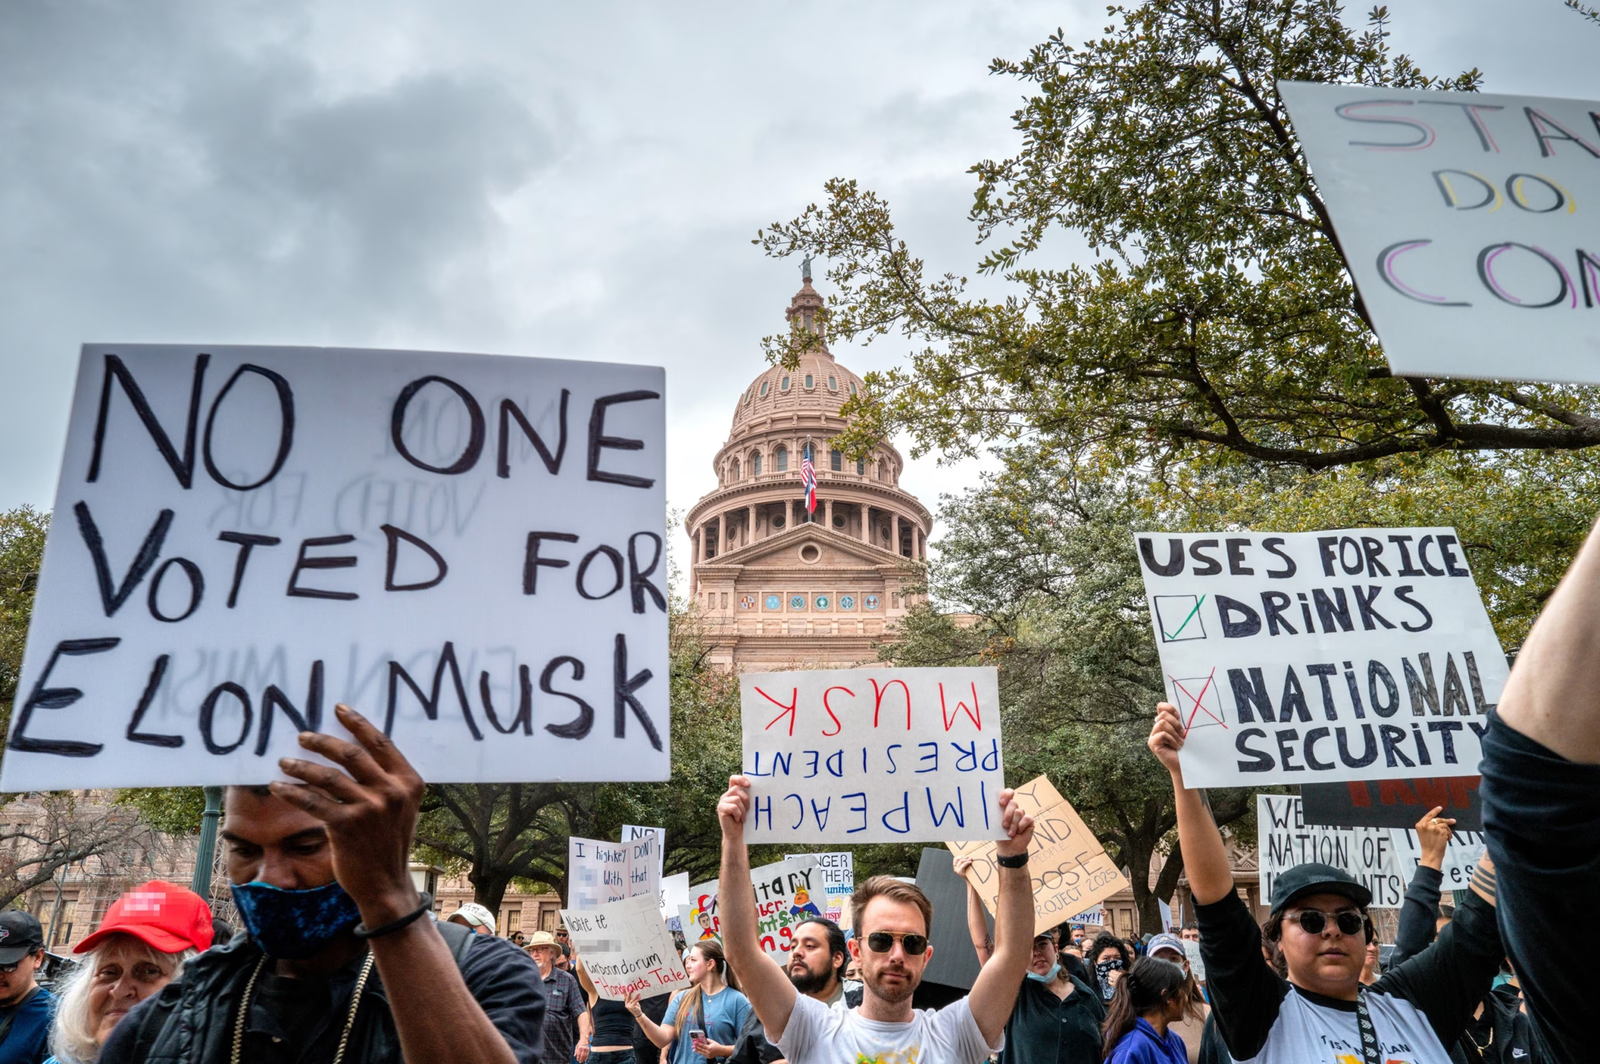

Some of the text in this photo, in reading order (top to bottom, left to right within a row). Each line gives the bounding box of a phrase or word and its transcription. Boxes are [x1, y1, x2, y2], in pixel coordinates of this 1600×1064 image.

[1334, 99, 1600, 159] STA
[86, 353, 660, 491] NO ONE
[74, 500, 668, 623] VOTED FOR
[1138, 535, 1469, 579] USES FOR ICE
[10, 633, 664, 757] ELON MUSK
[754, 677, 981, 737] MUSK
[743, 738, 999, 778] PRESIDENT
[754, 781, 989, 834] IMPEACH
[575, 842, 586, 858] I
[1268, 833, 1348, 868] NATION
[1362, 836, 1390, 869] OF
[630, 865, 647, 884] that
[1035, 869, 1118, 918] ROJECT 2025
[595, 914, 608, 929] te
[648, 967, 686, 985] Tale
